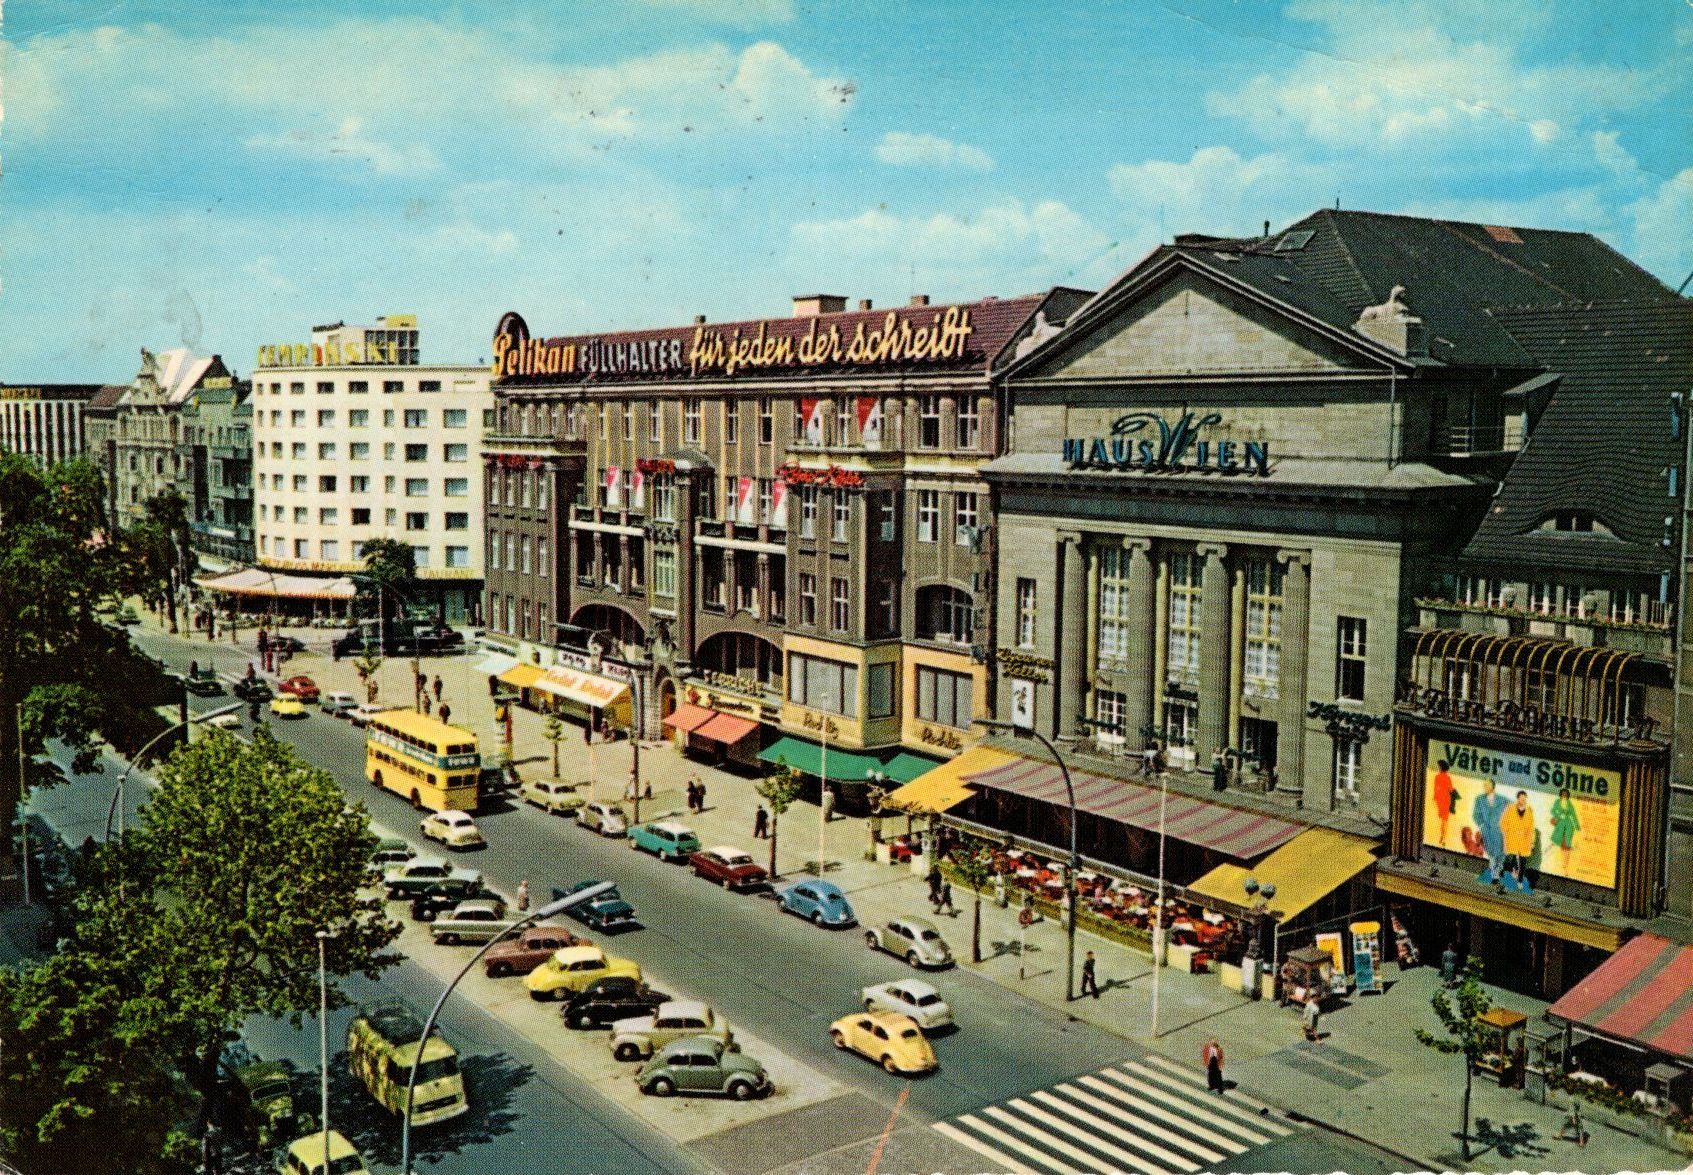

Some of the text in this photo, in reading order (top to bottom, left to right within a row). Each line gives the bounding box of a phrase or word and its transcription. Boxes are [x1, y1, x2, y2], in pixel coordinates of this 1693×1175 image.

[492, 305, 974, 377] Pelikan FÜLLHALTER für jeden der schreibt
[1063, 412, 1269, 476] HAUS WIEN
[1444, 743, 1609, 797] Väter und Söhne
